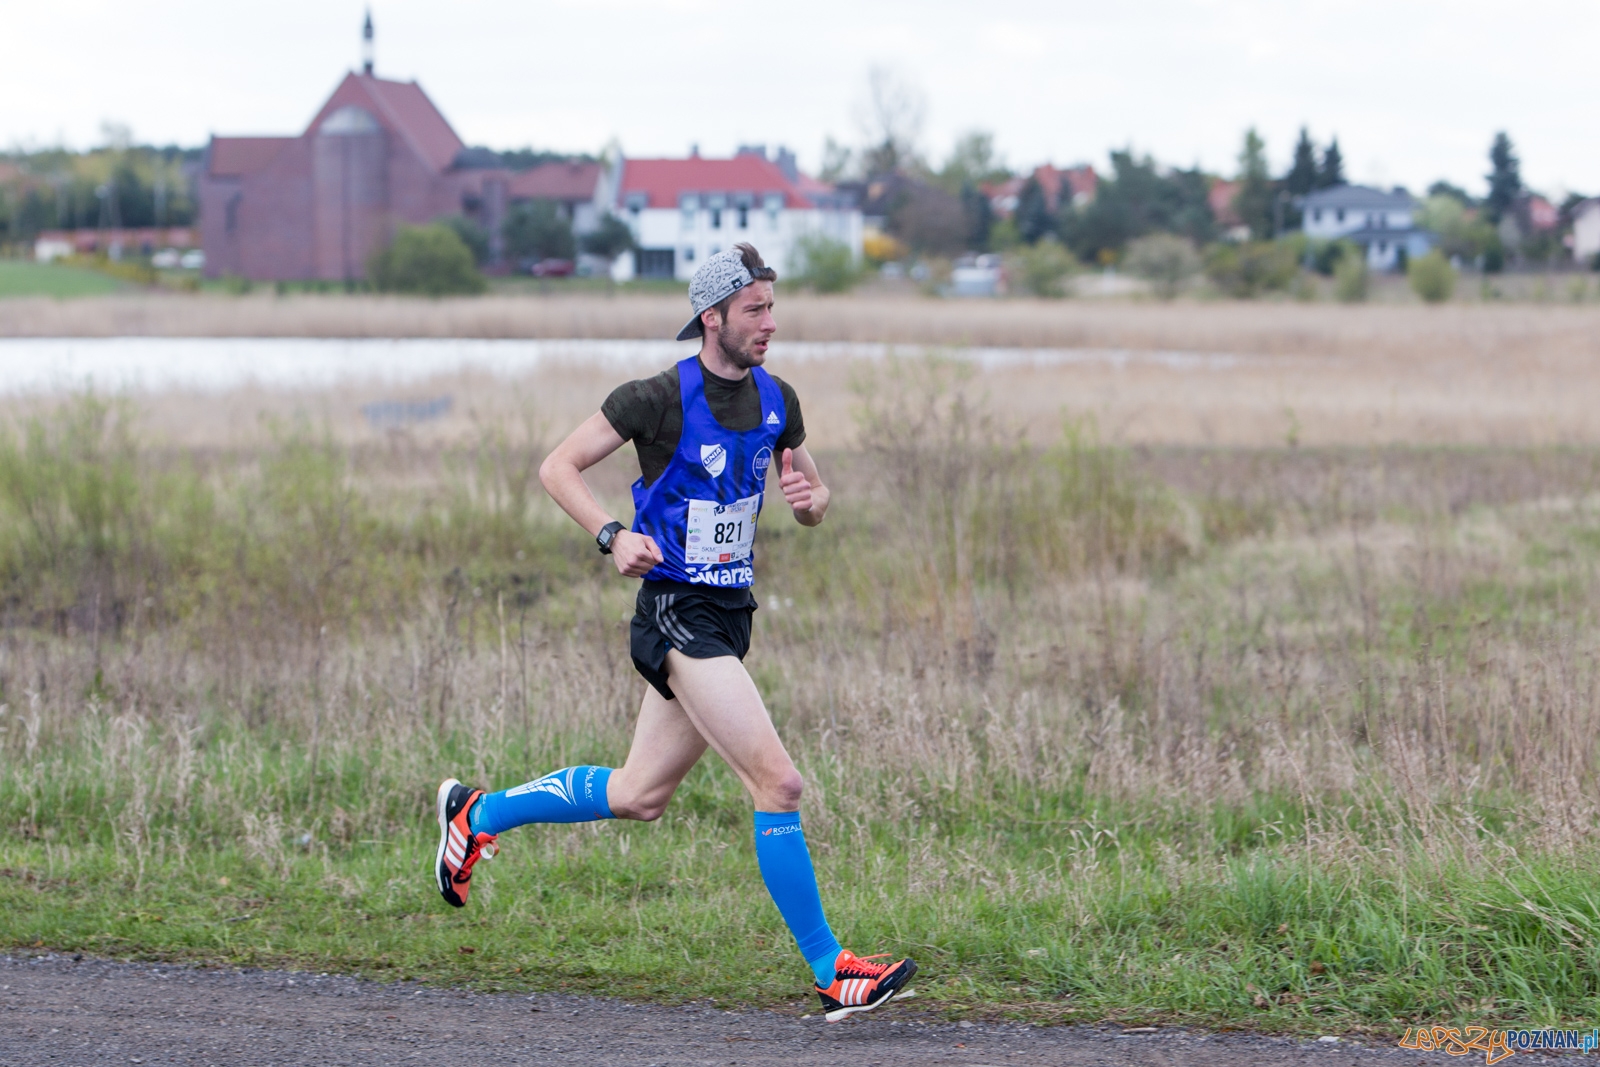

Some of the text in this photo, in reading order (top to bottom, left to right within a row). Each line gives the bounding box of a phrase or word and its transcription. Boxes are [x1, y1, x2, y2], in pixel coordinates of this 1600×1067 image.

[704, 447, 722, 465] UNIA
[713, 520, 742, 545] 821
[685, 567, 753, 586] Swarzę
